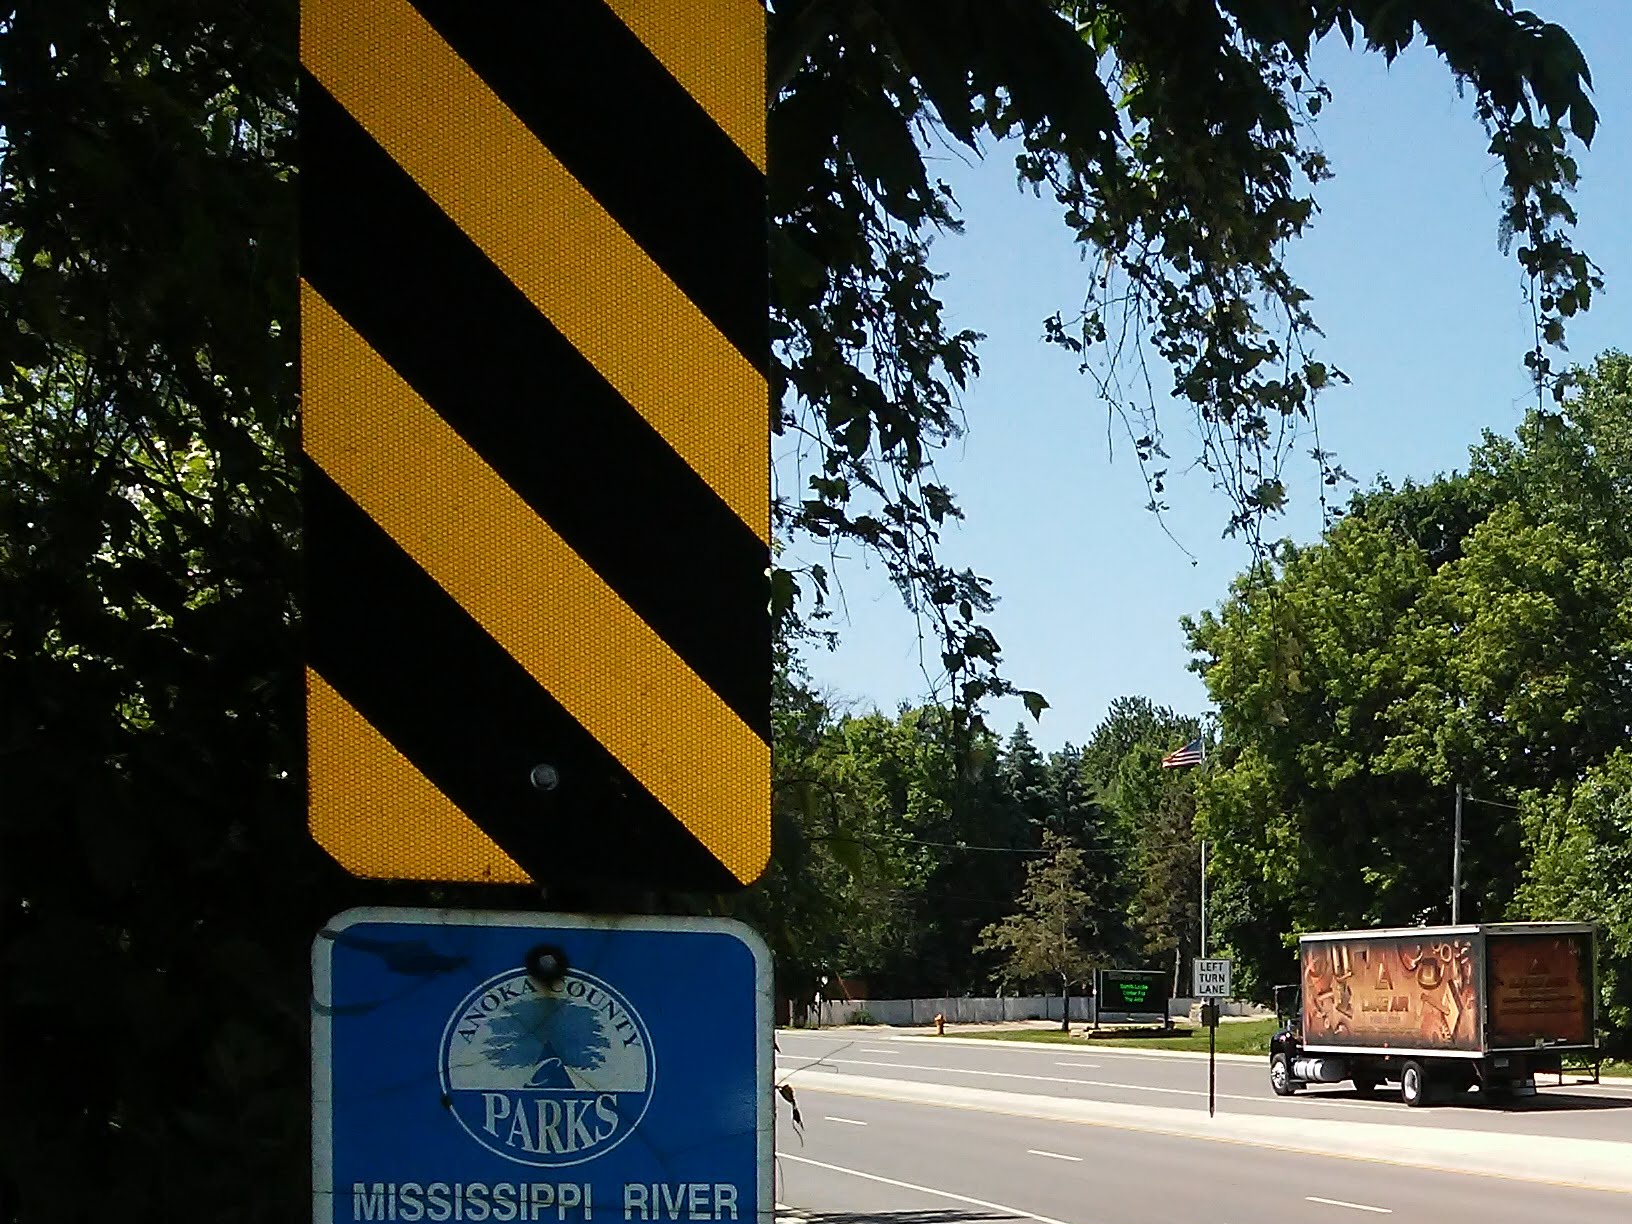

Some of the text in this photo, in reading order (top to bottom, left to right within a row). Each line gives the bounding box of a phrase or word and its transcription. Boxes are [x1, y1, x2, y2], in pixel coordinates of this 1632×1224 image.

[1199, 973, 1225, 983] TURN
[1200, 962, 1223, 971] LEFT
[1199, 985, 1225, 994] LANE
[458, 975, 642, 1049] ANOKA COUNTY
[481, 1092, 619, 1154] PARKS
[352, 1182, 739, 1222] MISSISSIPPI RIVER
